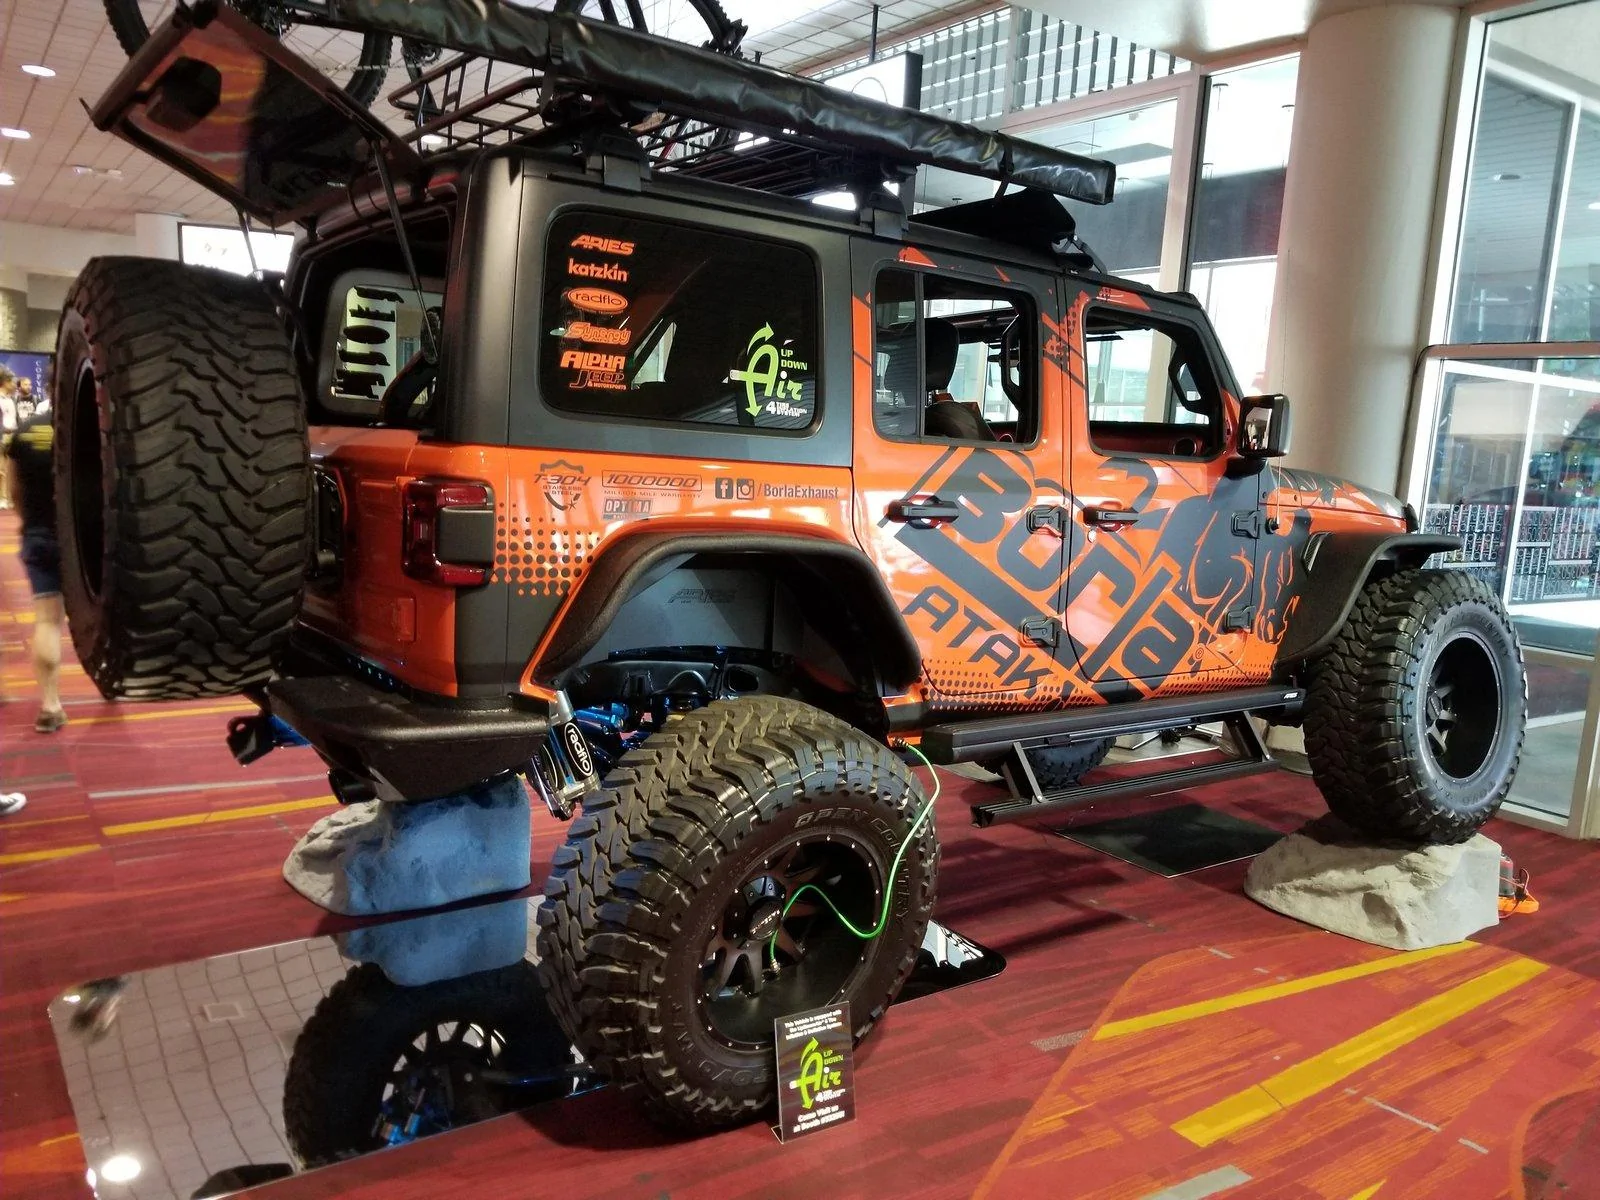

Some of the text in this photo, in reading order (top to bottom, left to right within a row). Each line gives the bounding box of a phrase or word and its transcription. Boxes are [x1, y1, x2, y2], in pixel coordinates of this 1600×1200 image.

[571, 235, 635, 255] ARIES
[568, 257, 628, 282] katzkin
[575, 293, 622, 305] radflo
[564, 321, 632, 346] Synergy
[560, 350, 626, 371] ALPHA
[780, 349, 794, 358] UP
[742, 343, 803, 402] Air
[780, 359, 808, 371] DOWN
[765, 400, 777, 415] 4
[534, 473, 592, 486] T-304
[606, 473, 698, 488] 1000000
[901, 584, 1054, 700] ATAK
[567, 728, 592, 774] radflo
